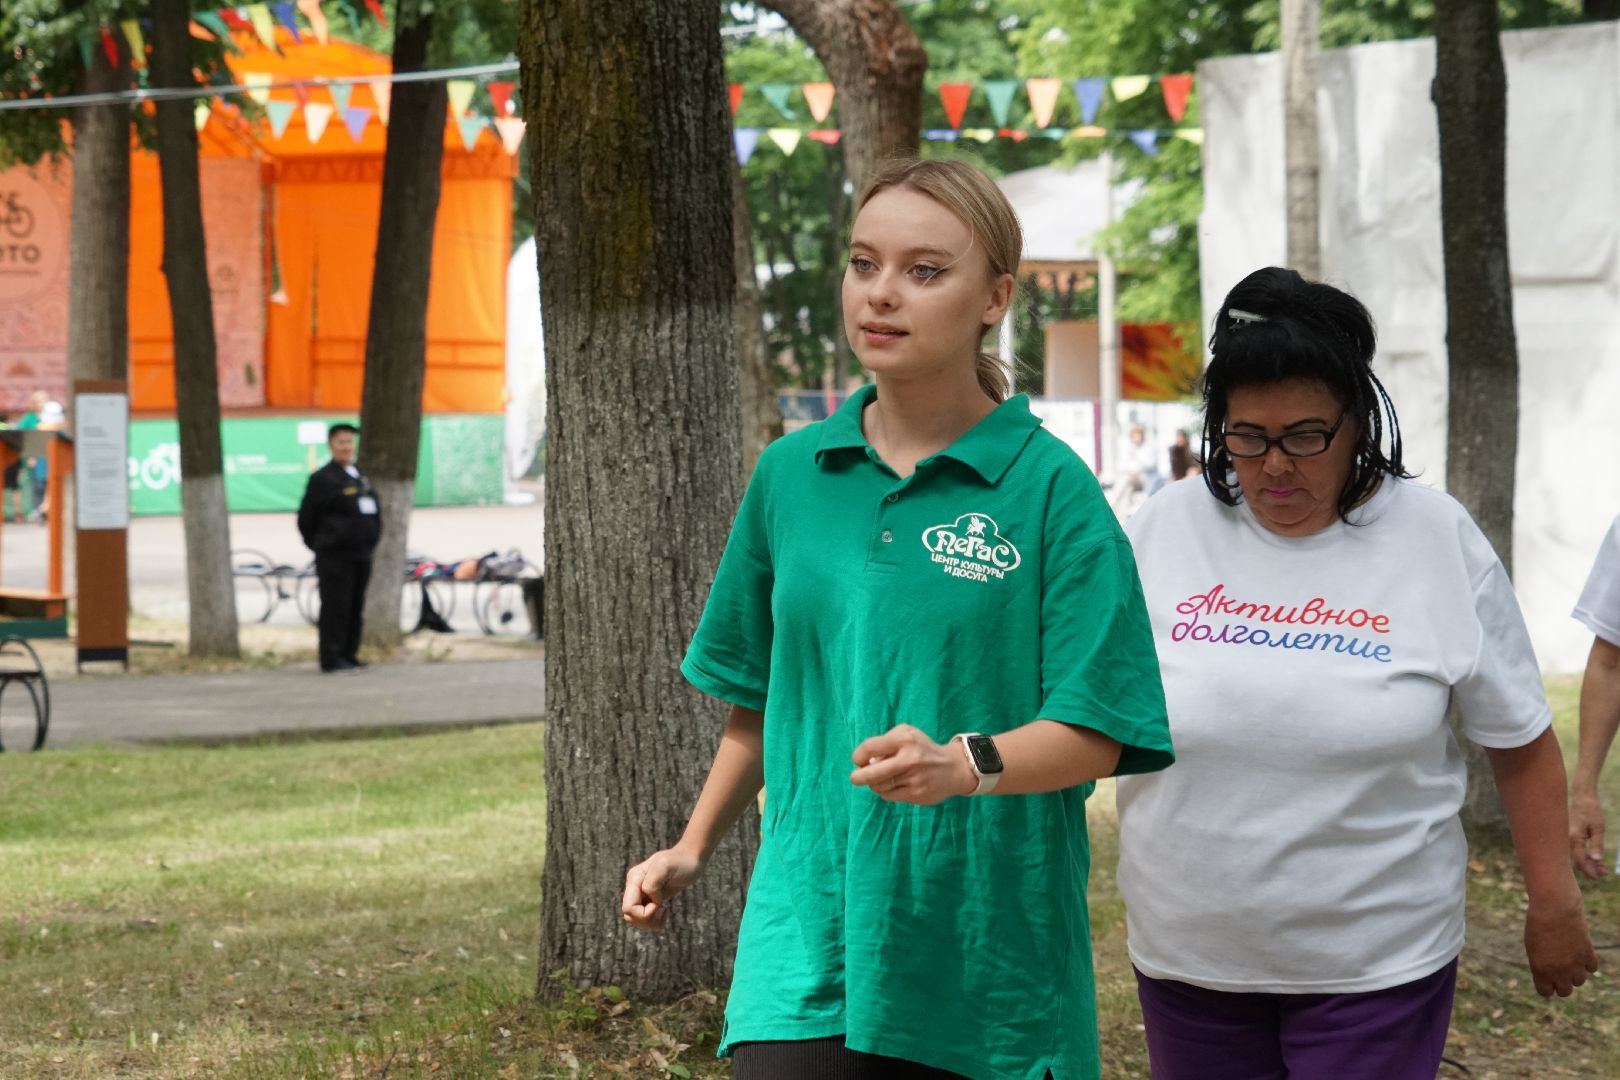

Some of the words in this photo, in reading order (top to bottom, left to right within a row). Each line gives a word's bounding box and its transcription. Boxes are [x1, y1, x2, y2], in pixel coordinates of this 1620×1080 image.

[931, 552, 960, 565] ЦЕНТР
[960, 560, 1005, 579] КУЛЬТУРЫ
[943, 565, 952, 574] И
[952, 569, 988, 583] ДОСУГА
[1176, 584, 1391, 633] Активное
[1171, 611, 1392, 662] долголетие
